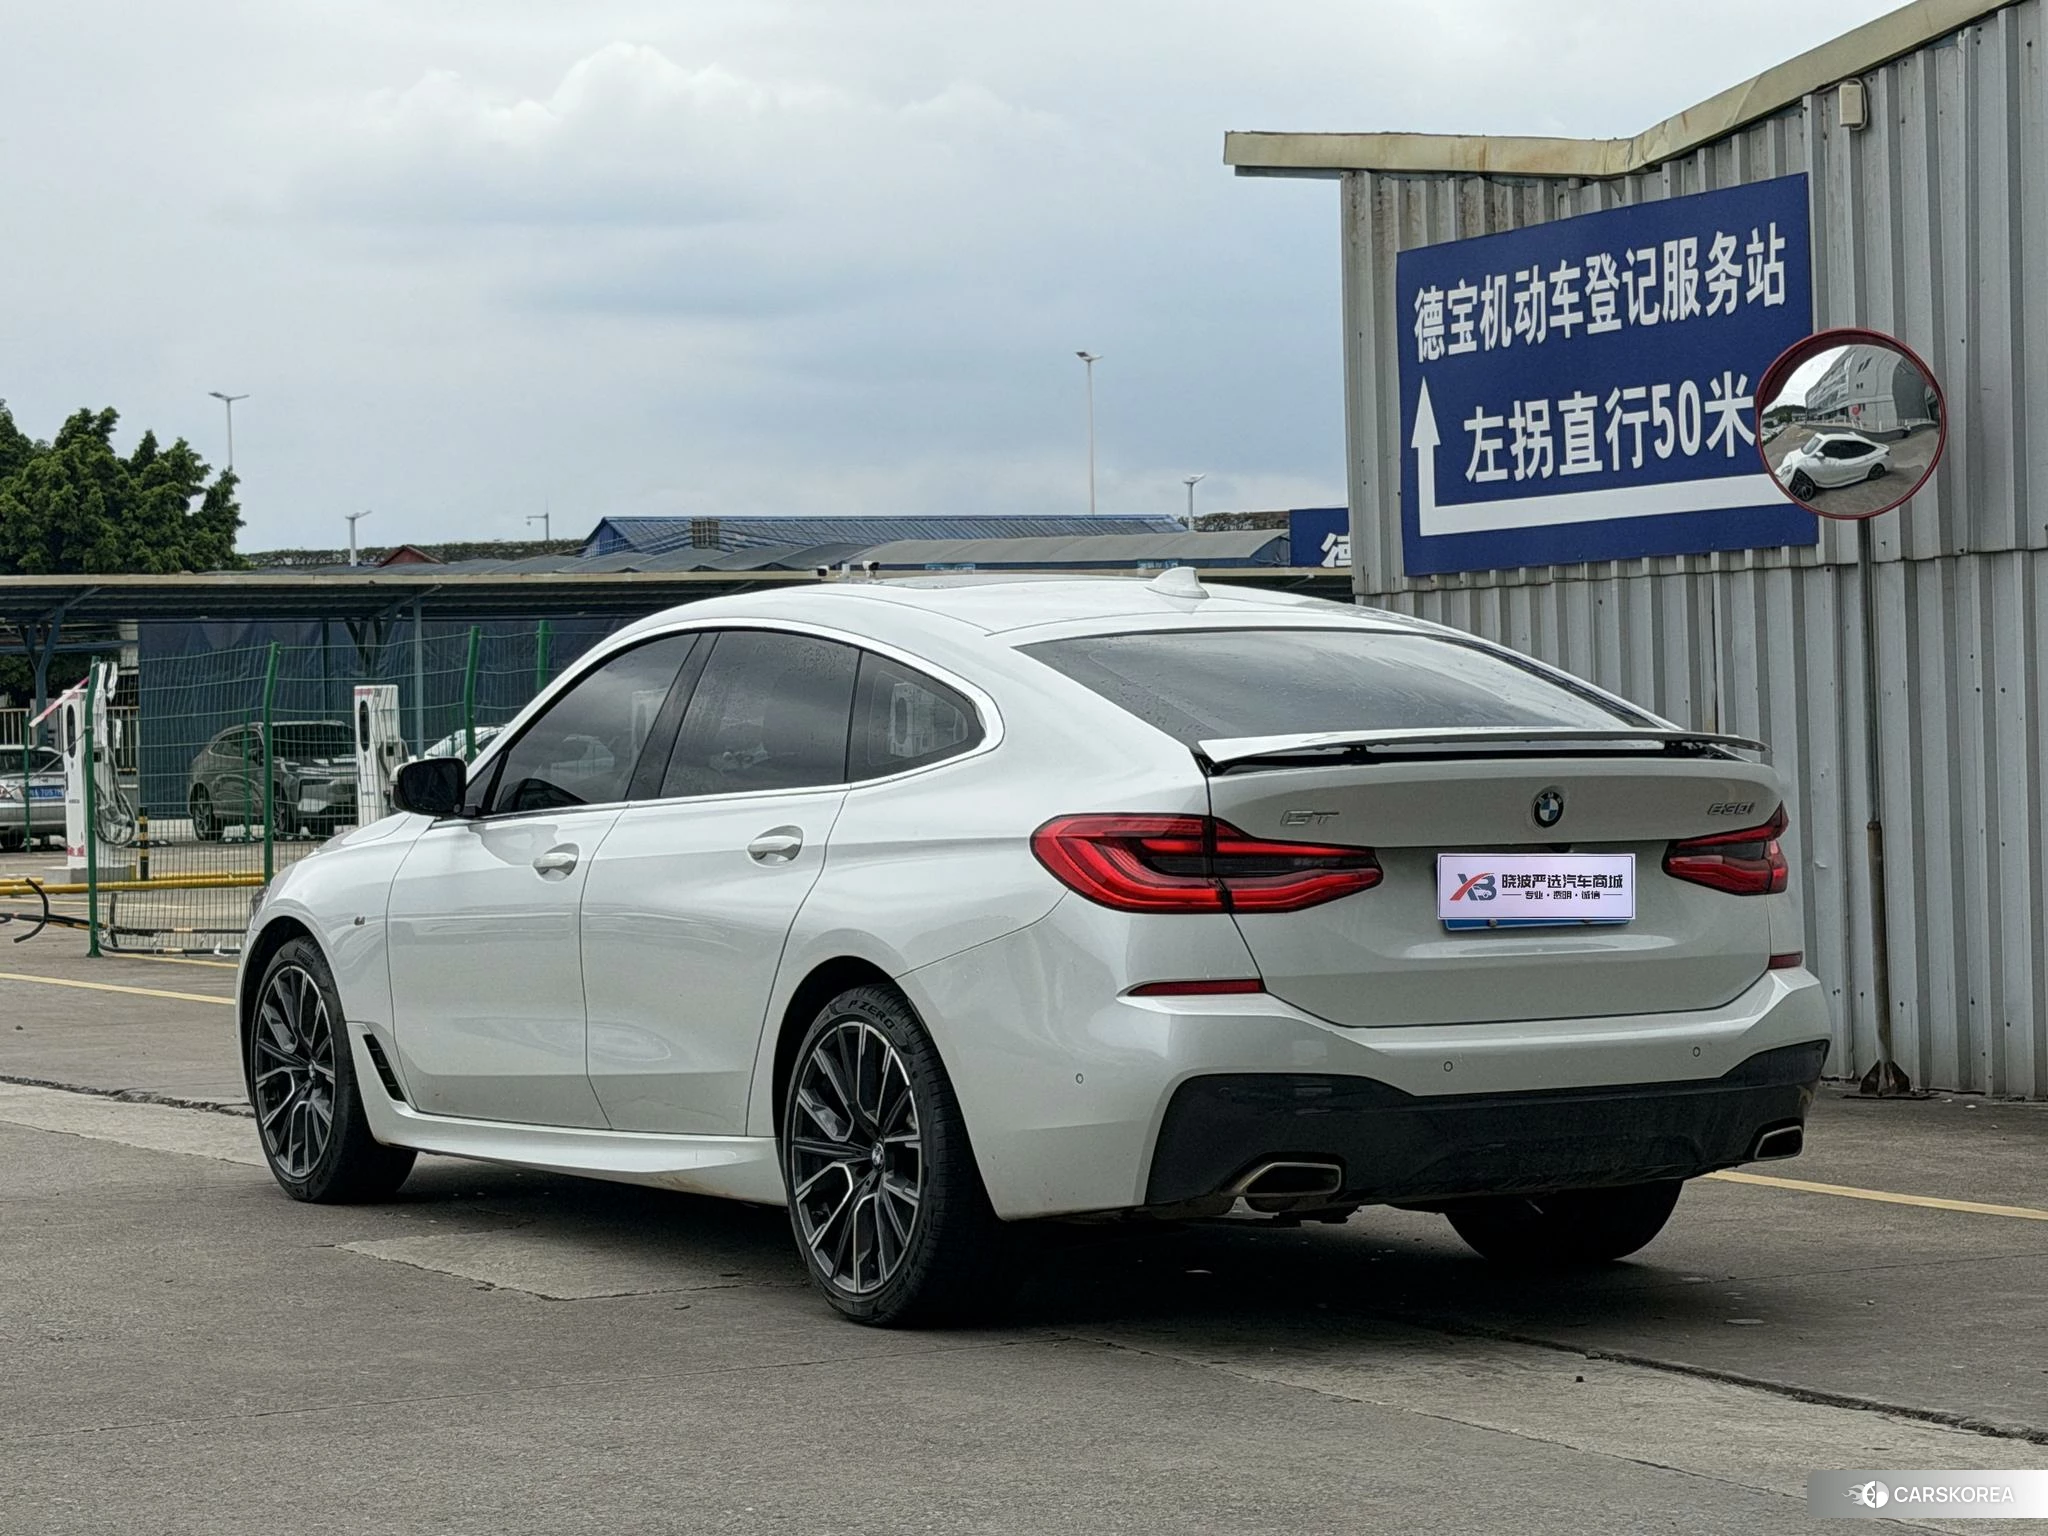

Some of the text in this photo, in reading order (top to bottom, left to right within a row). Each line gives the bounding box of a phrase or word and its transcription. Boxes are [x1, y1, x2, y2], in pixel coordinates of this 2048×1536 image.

[1414, 222, 1786, 363] 德宝机动车登记服务站
[1464, 371, 1756, 484] 左拐直行50米
[1502, 874, 1623, 888] 晓波严选汽车商城
[859, 1001, 895, 1030] ZERO
